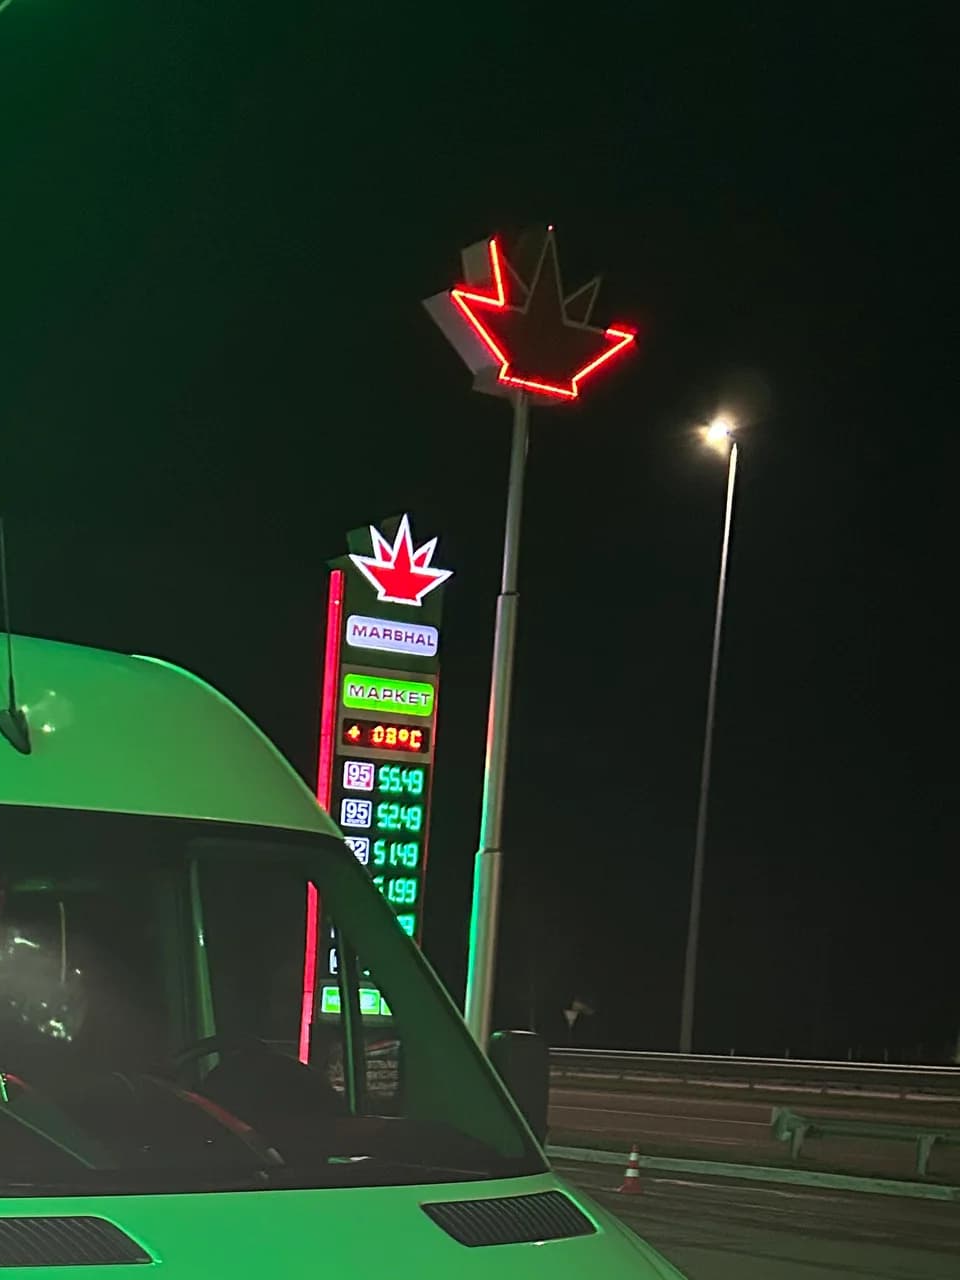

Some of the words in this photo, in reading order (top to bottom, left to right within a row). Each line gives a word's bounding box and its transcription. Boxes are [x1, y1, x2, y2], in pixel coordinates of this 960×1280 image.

[352, 624, 435, 647] MARSHAL
[349, 684, 431, 705] МАРКЕТ
[349, 764, 370, 782] 95
[346, 802, 368, 820] 95
